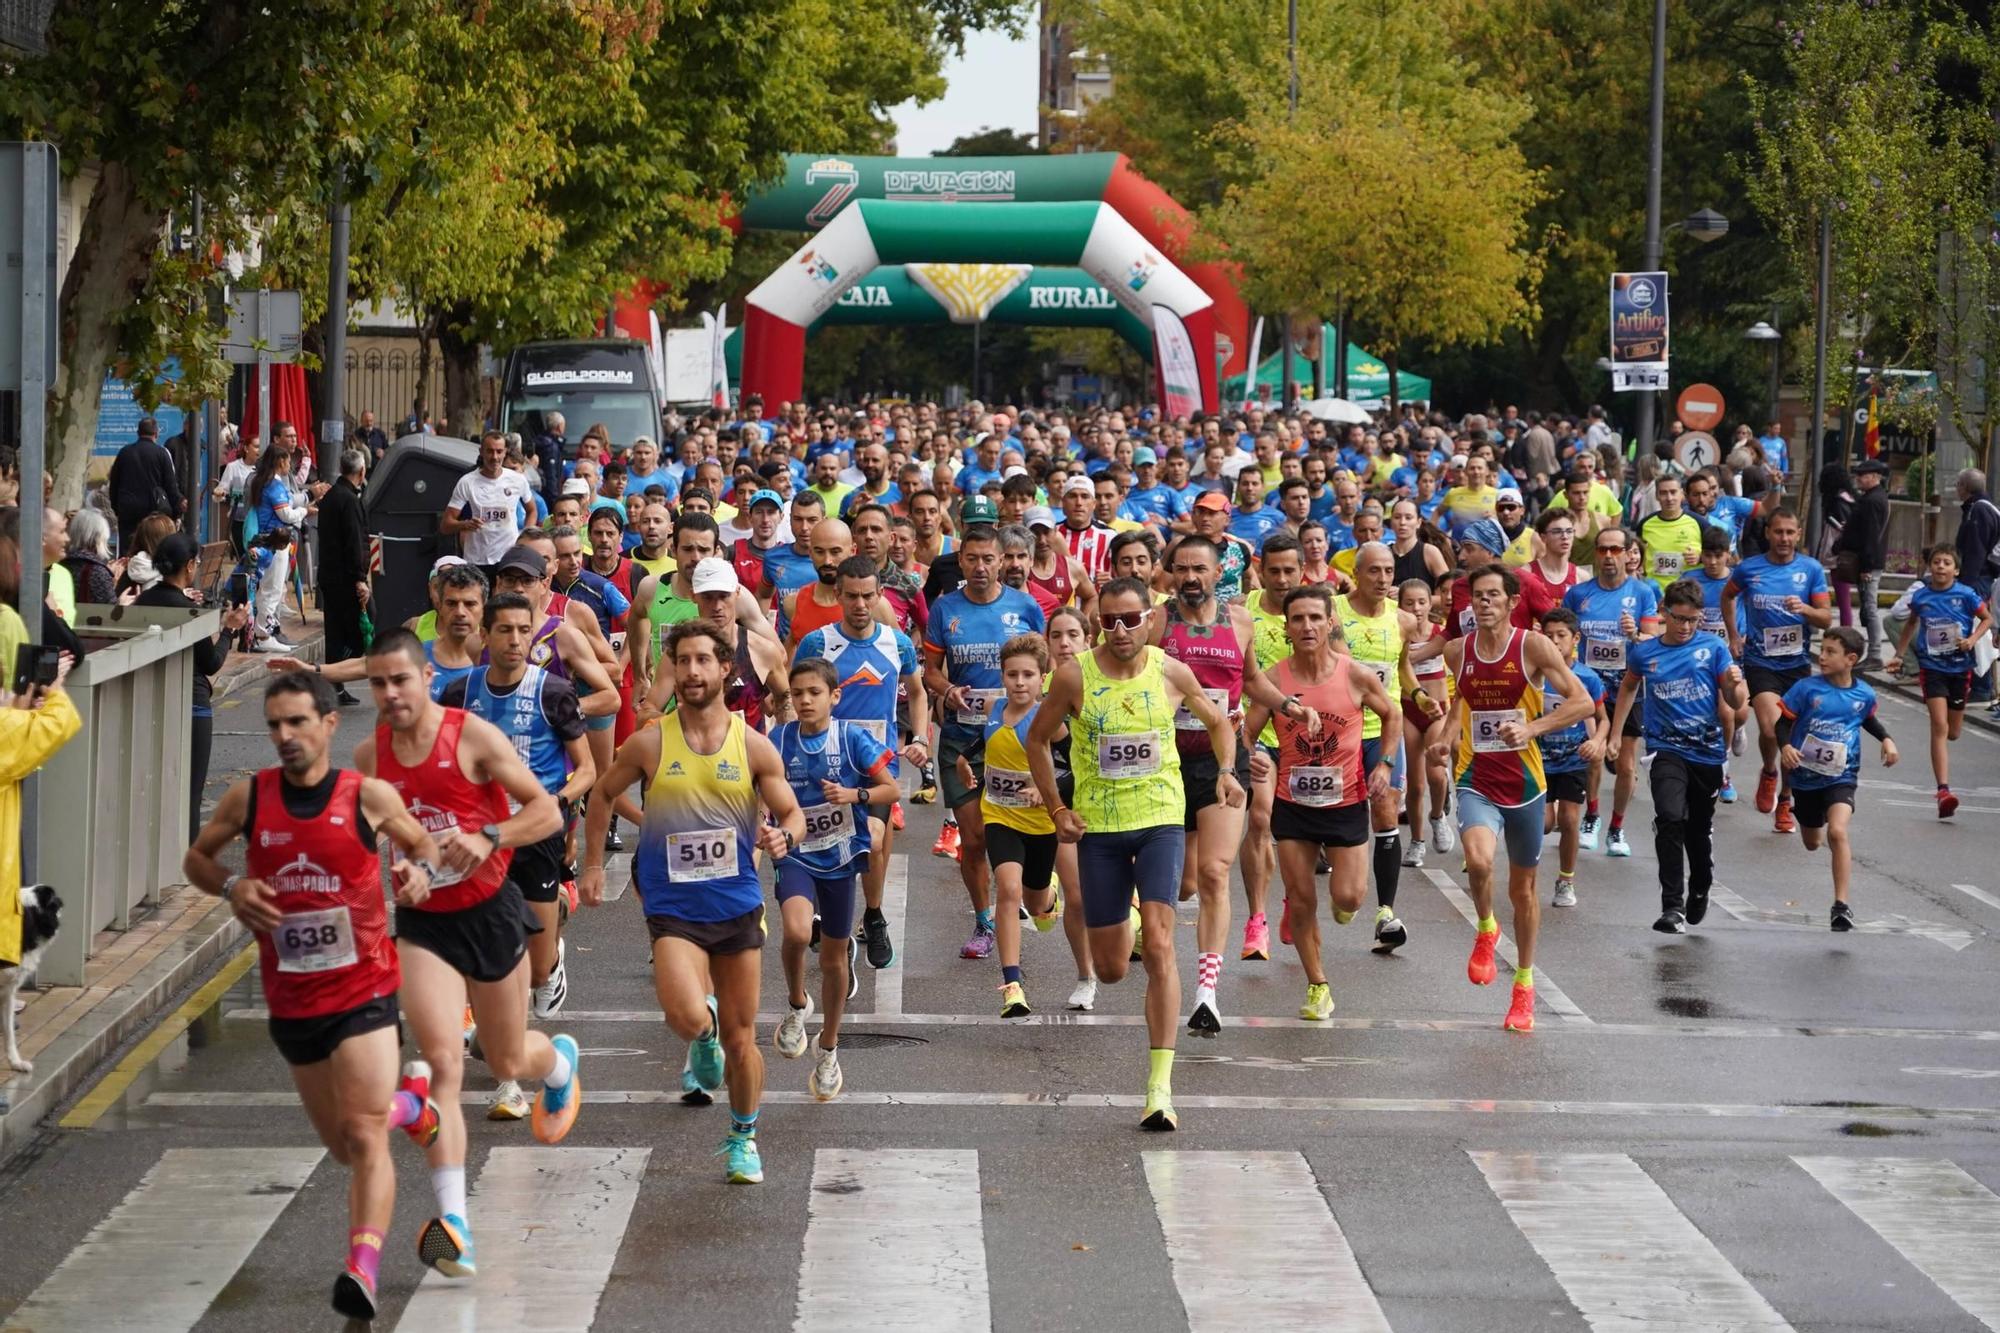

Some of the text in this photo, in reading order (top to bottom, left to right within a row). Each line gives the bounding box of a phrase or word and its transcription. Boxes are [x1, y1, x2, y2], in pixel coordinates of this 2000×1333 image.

[838, 286, 893, 306] CAJA
[1029, 286, 1117, 308] RURAL
[487, 511, 506, 520] 198
[1771, 632, 1797, 645] 748
[1939, 631, 1949, 642] 2
[951, 644, 970, 656] XIV
[1185, 646, 1236, 659] APIS DURI
[1592, 646, 1620, 658] 606
[1478, 689, 1501, 697] VINO
[1484, 697, 1510, 705] TORO
[1109, 743, 1151, 762] 596
[1815, 747, 1835, 762] 13
[992, 776, 1026, 793] 522
[1297, 776, 1334, 791] 682
[805, 810, 843, 834] 560
[680, 841, 726, 862] 510
[303, 875, 341, 893] PABLO
[285, 924, 338, 949] 638
